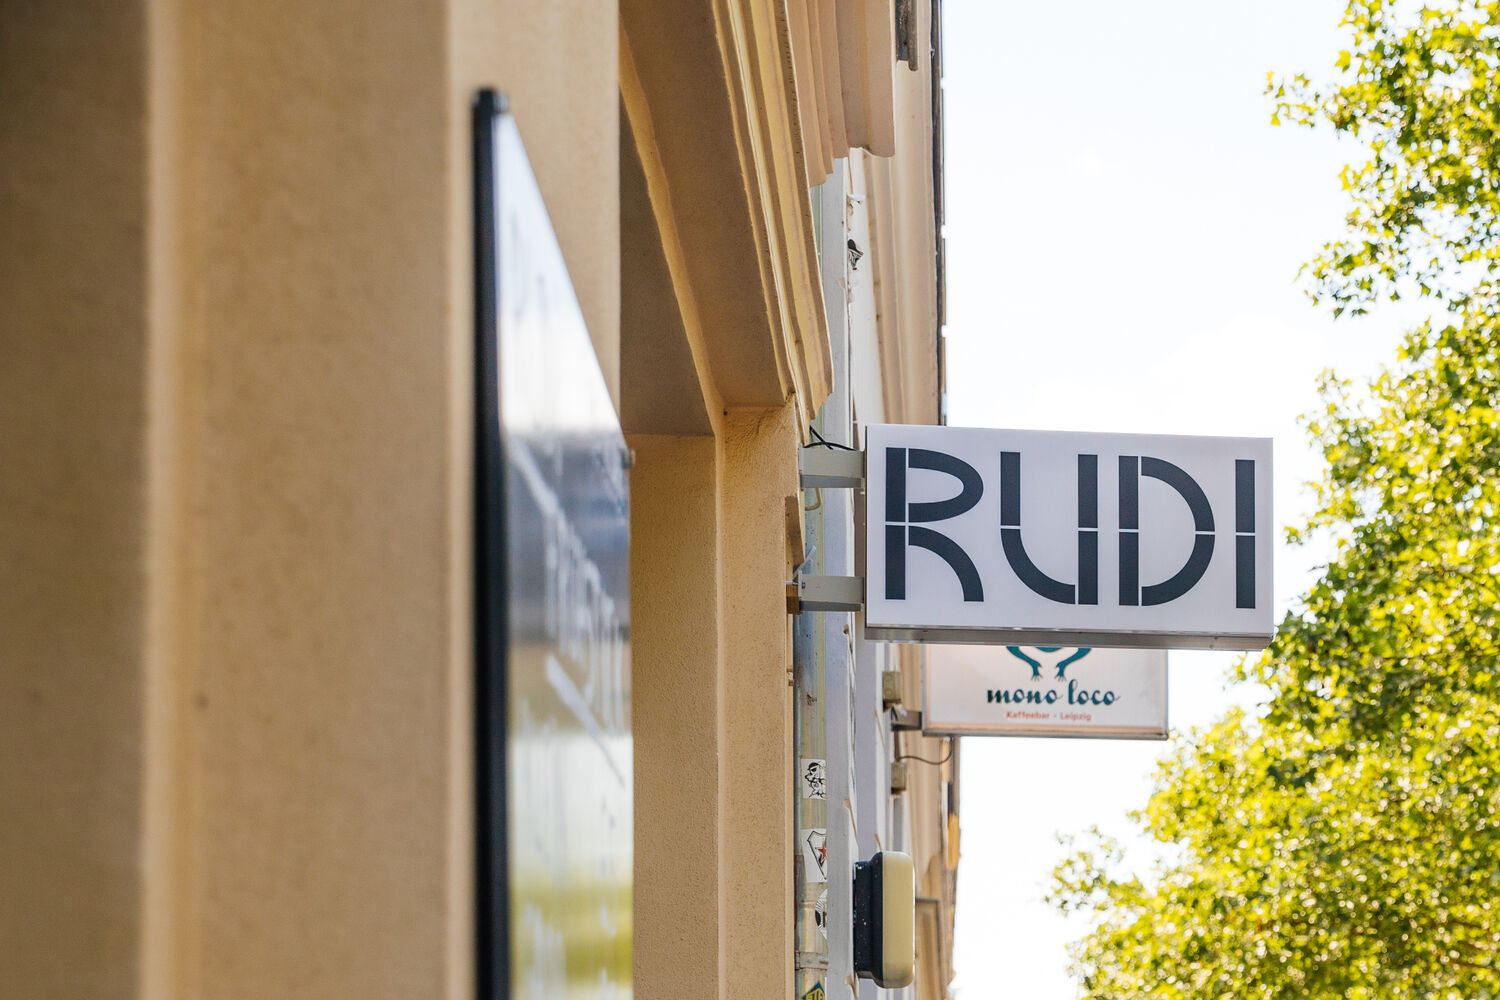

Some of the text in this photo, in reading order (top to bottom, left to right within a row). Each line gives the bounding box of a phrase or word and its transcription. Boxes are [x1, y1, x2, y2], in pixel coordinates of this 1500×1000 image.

[885, 447, 1256, 609] RUDI
[986, 678, 1121, 706] mono loco
[1060, 711, 1093, 722] Leipzig
